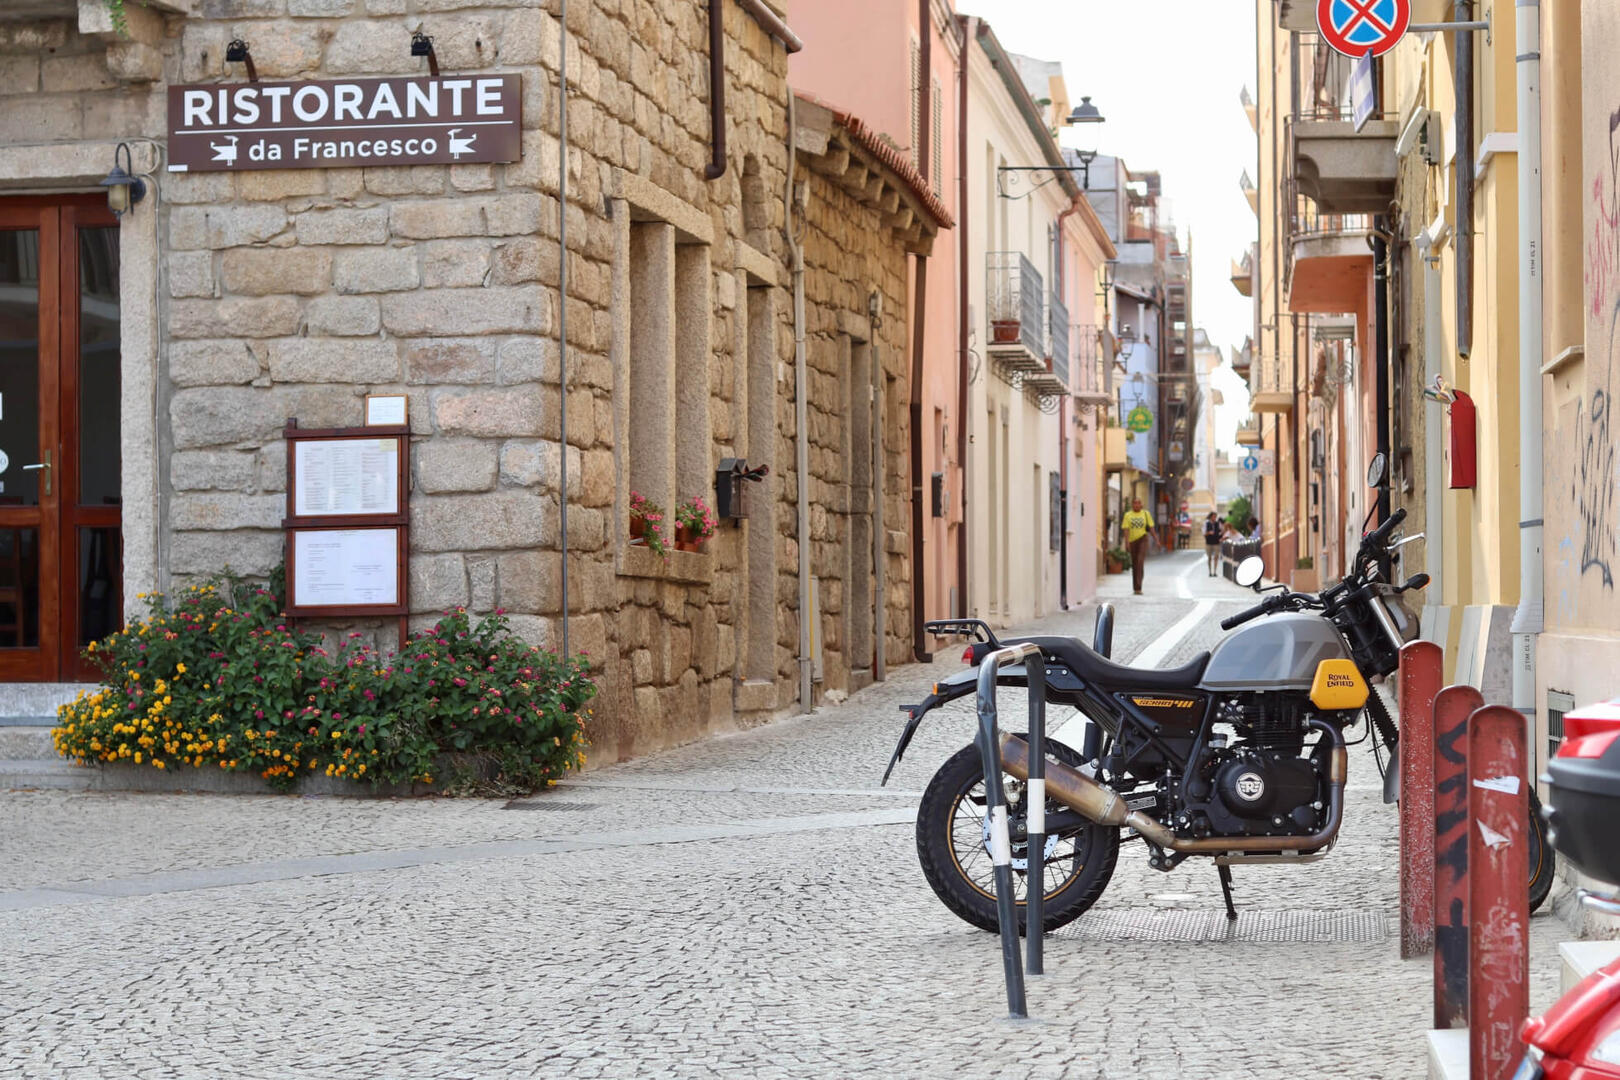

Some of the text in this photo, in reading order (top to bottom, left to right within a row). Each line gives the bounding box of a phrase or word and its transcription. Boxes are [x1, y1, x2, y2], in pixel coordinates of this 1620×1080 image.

[183, 78, 504, 126] RISTORANTE
[249, 137, 438, 161] da Francesco
[1327, 680, 1354, 688] ENFIELD
[1328, 673, 1351, 681] ROYAL
